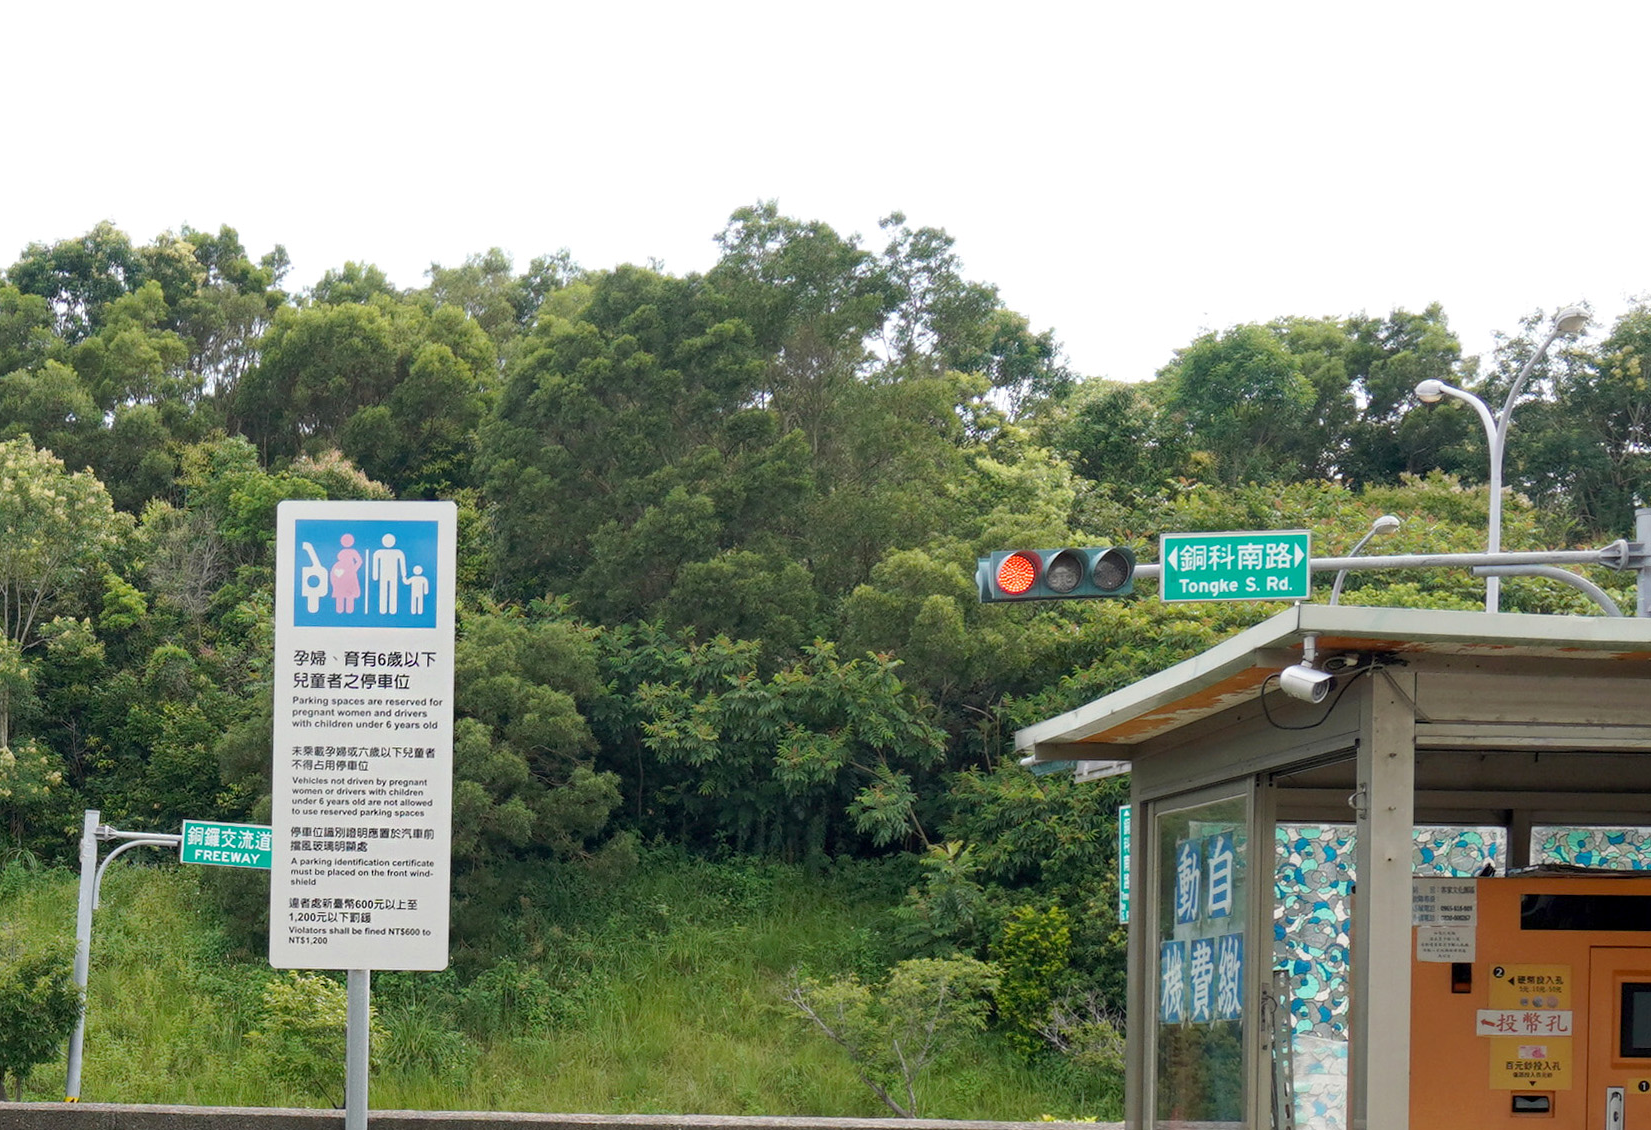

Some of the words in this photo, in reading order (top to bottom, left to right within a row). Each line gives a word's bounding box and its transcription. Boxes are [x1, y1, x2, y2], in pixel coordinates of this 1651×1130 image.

[1180, 543, 1293, 571] 銅科南路
[1179, 578, 1238, 596] Tongke
[1245, 577, 1260, 591] S.
[1267, 576, 1293, 591] Rd.
[294, 650, 436, 667] 孕婦、育有6歲以下
[293, 673, 410, 689] 兒童者之停車位
[293, 696, 328, 706] Parking
[332, 698, 364, 707] spaces
[292, 710, 334, 718] pregnant
[315, 720, 352, 728] children
[292, 760, 369, 771] 不得占用停車位
[377, 778, 386, 786] by
[389, 779, 427, 787] pregnant
[360, 809, 392, 818] parking
[187, 826, 272, 851] 銅鑼交流道
[290, 841, 368, 852] 擋風玻璃明顯處
[195, 849, 260, 864] FREEWAY
[300, 858, 332, 867] parking
[392, 859, 434, 867] certificate
[328, 869, 355, 877] placed
[387, 869, 407, 877] front
[1496, 1012, 1568, 1033] 投幣孔
